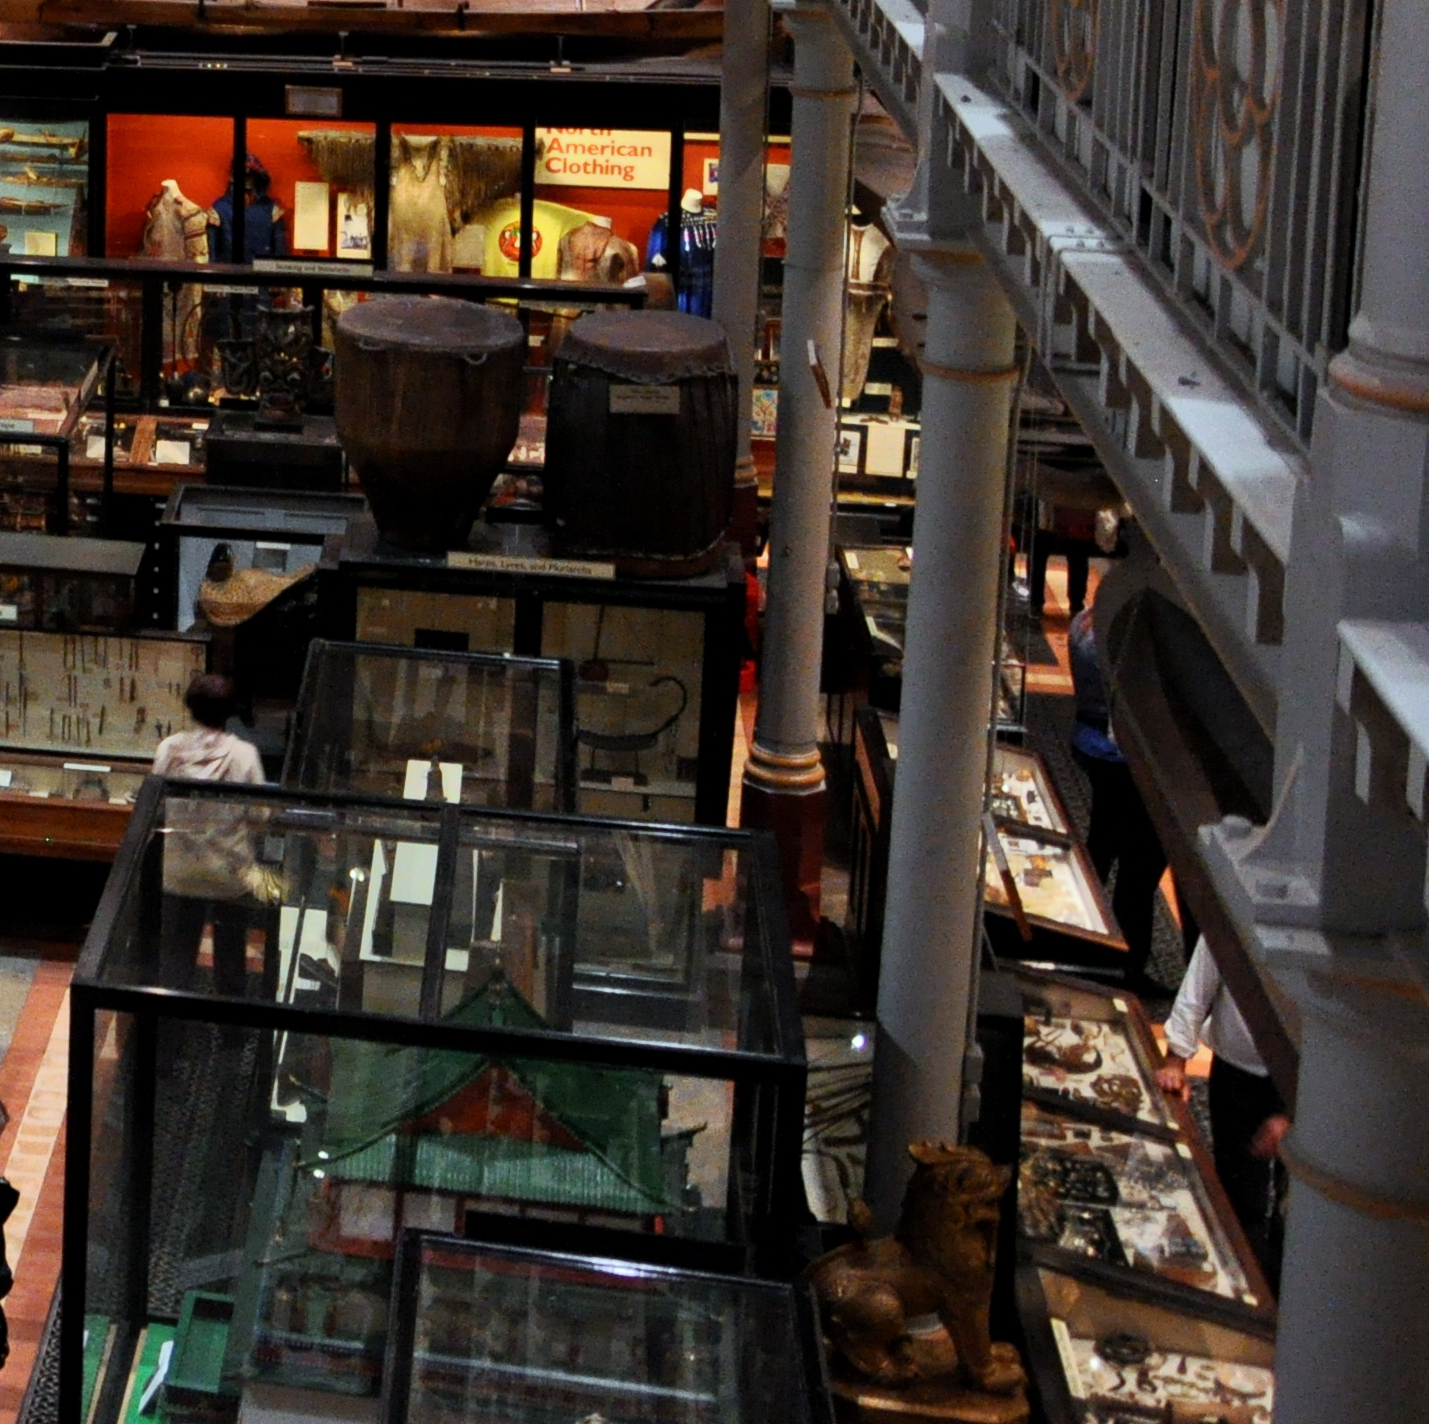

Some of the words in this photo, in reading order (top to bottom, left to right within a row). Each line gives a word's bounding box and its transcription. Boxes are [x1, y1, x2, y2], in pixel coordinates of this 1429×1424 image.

[547, 137, 653, 158] American
[545, 157, 635, 181] Clothing
[529, 562, 546, 571] and
